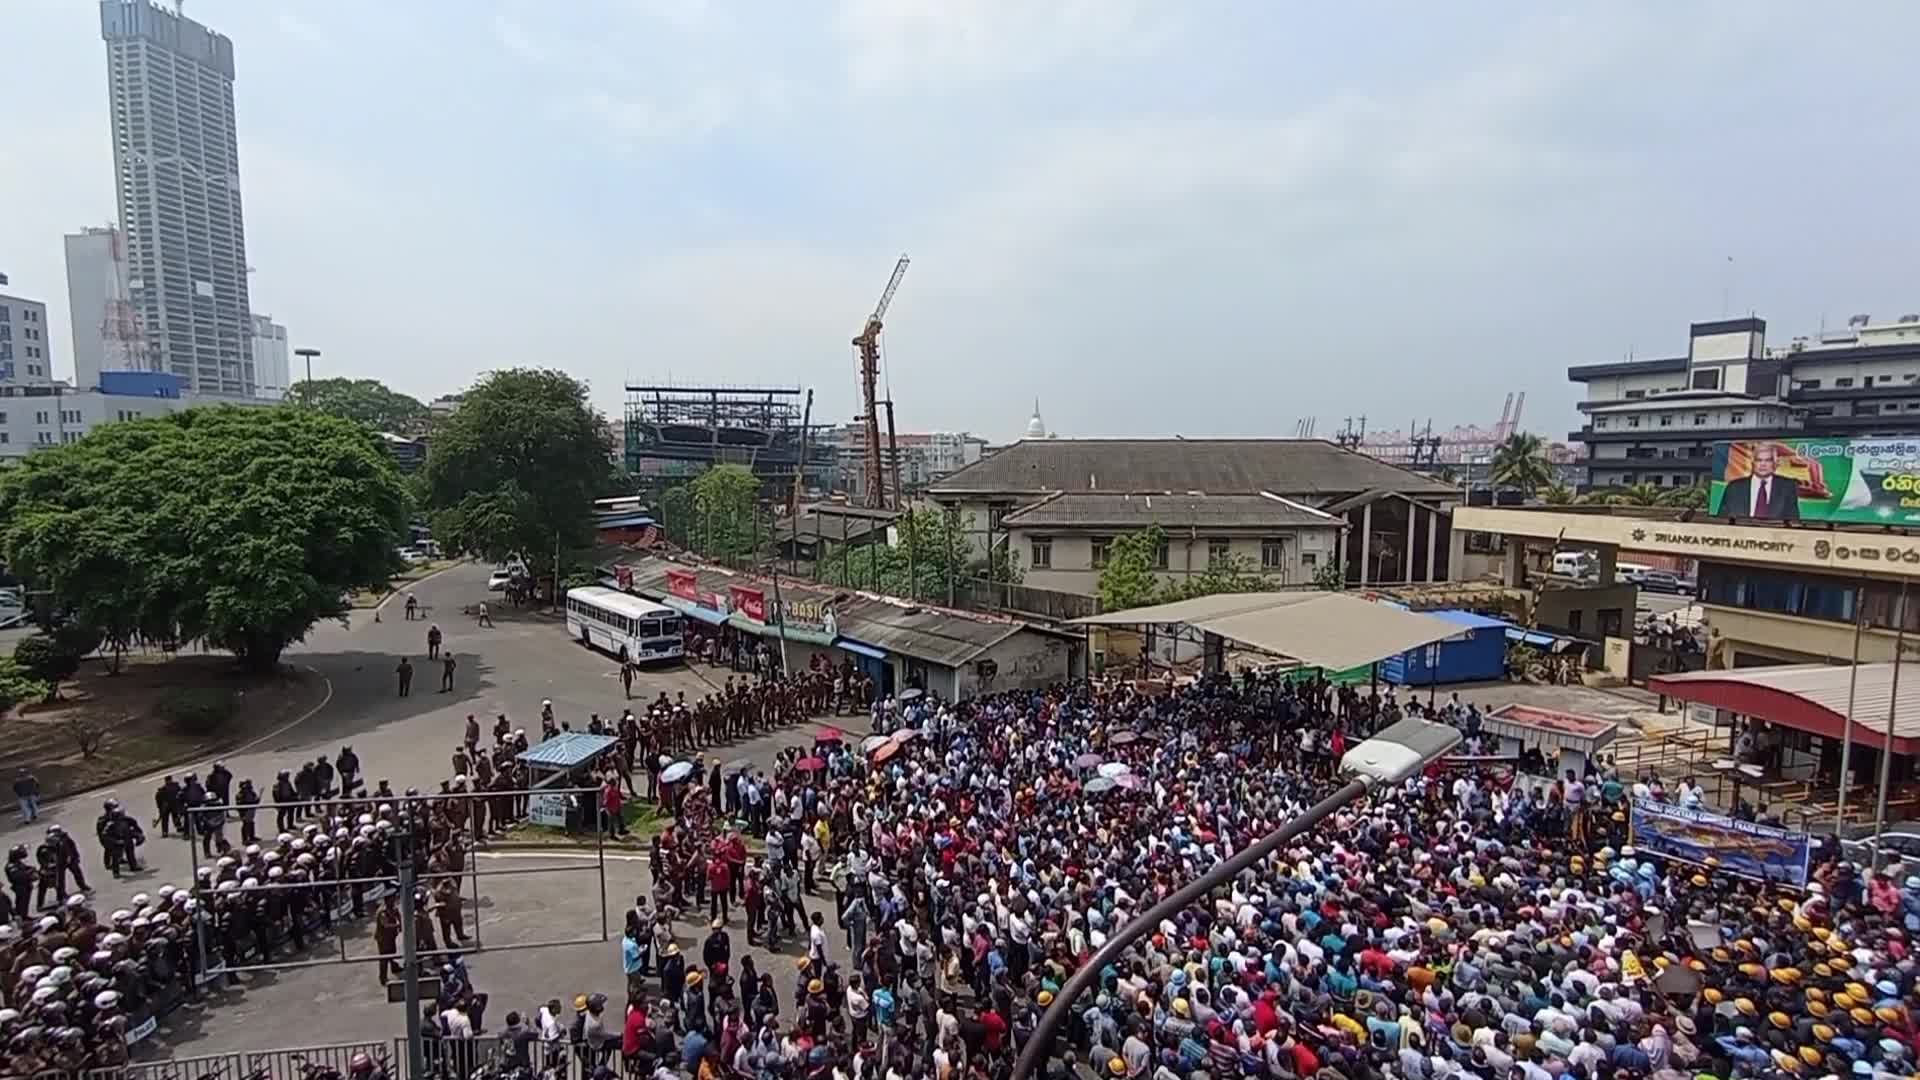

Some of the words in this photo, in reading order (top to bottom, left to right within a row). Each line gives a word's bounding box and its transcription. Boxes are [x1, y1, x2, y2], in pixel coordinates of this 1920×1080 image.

[1655, 532, 1667, 543] SRI
[1668, 534, 1699, 545] LANKA
[1701, 537, 1731, 547] PORTS
[1733, 539, 1794, 552] AUTHORITY
